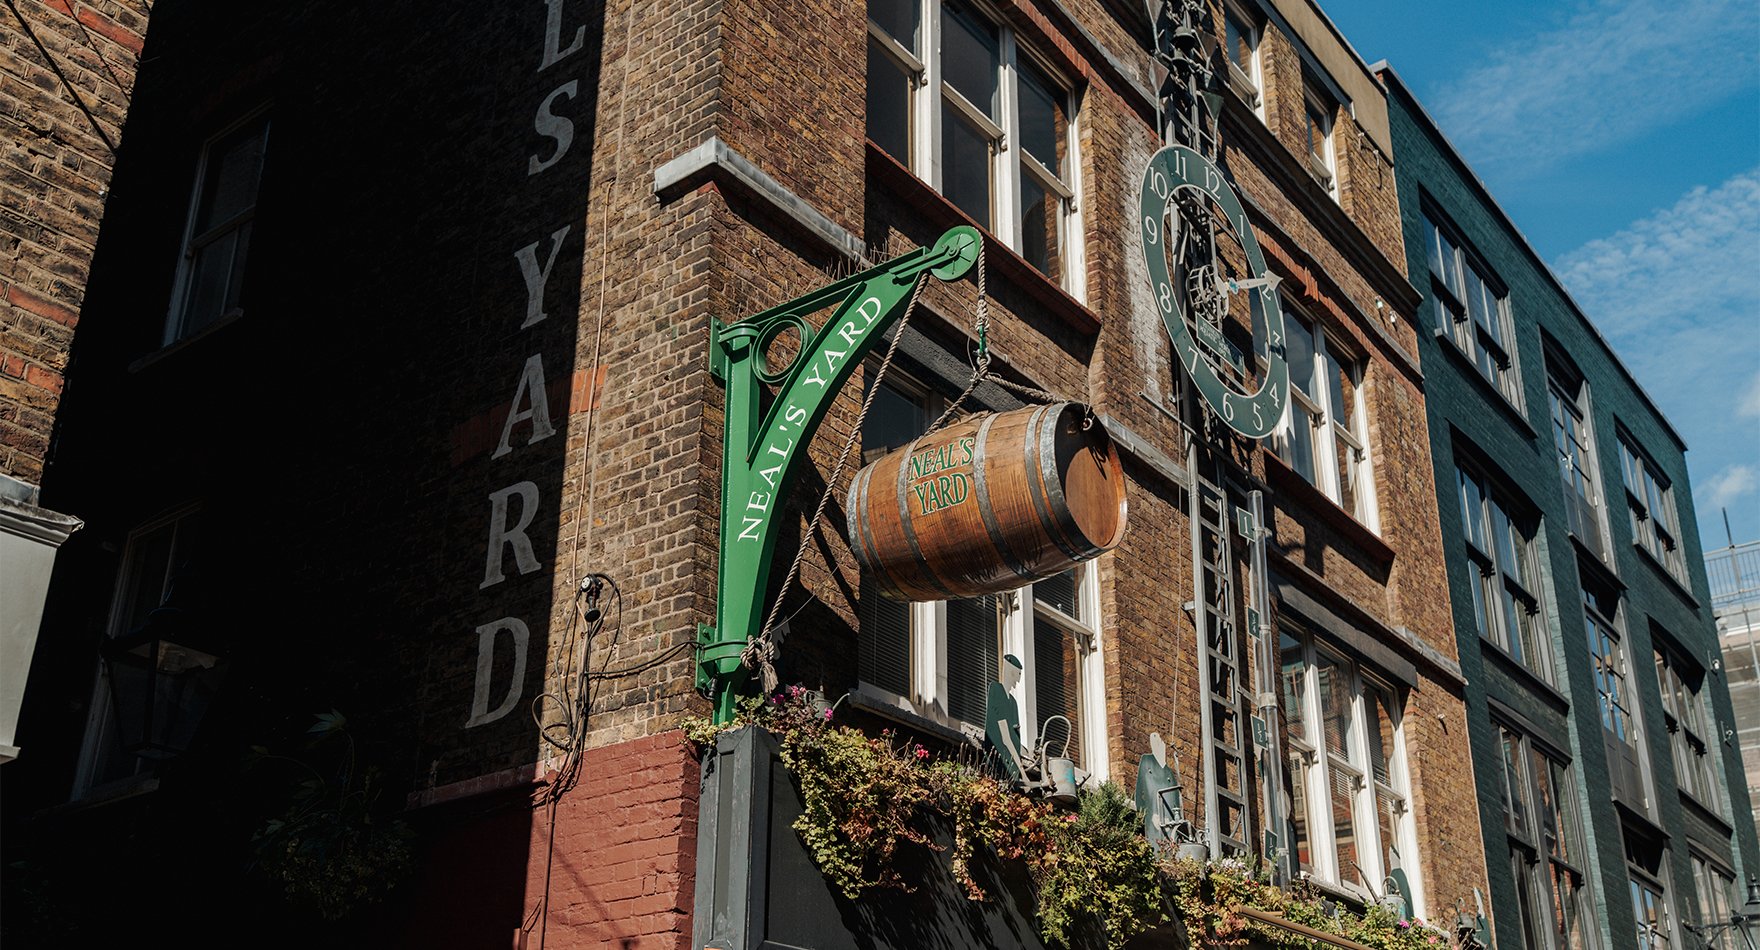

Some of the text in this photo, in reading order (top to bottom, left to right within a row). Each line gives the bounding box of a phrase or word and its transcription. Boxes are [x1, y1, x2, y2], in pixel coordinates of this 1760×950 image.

[1174, 149, 1187, 182] 11
[1150, 166, 1168, 200] 10
[1204, 166, 1221, 201] 12
[1145, 215, 1158, 245] 9
[1238, 213, 1245, 240] 1
[1160, 281, 1173, 314] 8
[1187, 345, 1199, 375] 7
[1272, 329, 1283, 360] 3
[1223, 391, 1235, 423] 6
[1269, 382, 1280, 409] 4
[737, 295, 882, 542] NEAL'S YARD
[1252, 401, 1264, 432] 5
[908, 438, 974, 481] NEAL'S
[464, 225, 572, 730] YARD
[914, 473, 969, 515] YARD
